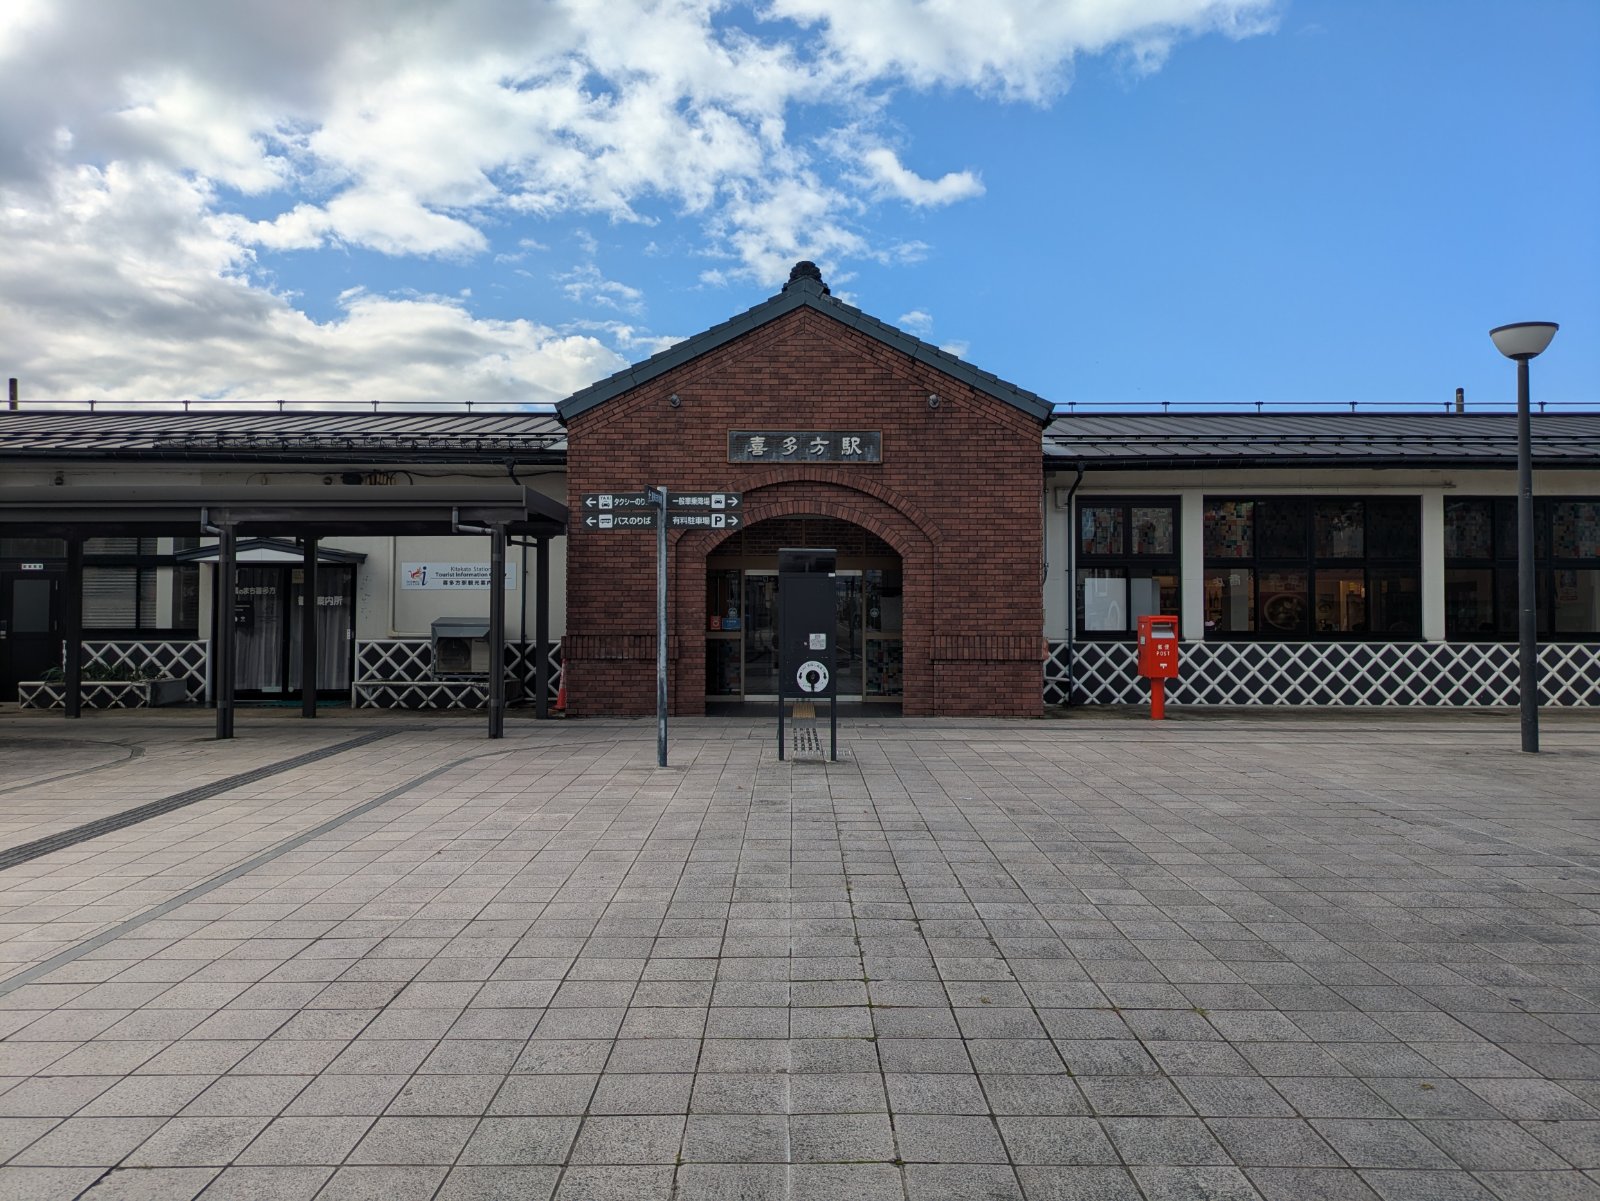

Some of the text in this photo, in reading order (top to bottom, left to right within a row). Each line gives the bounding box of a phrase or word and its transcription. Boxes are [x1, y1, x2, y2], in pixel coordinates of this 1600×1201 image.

[748, 436, 862, 456] 喜多方駅
[614, 498, 648, 506] タクシーのり
[614, 517, 651, 525] バスのりば
[672, 516, 710, 525] 有料駐車場
[714, 516, 722, 526] P
